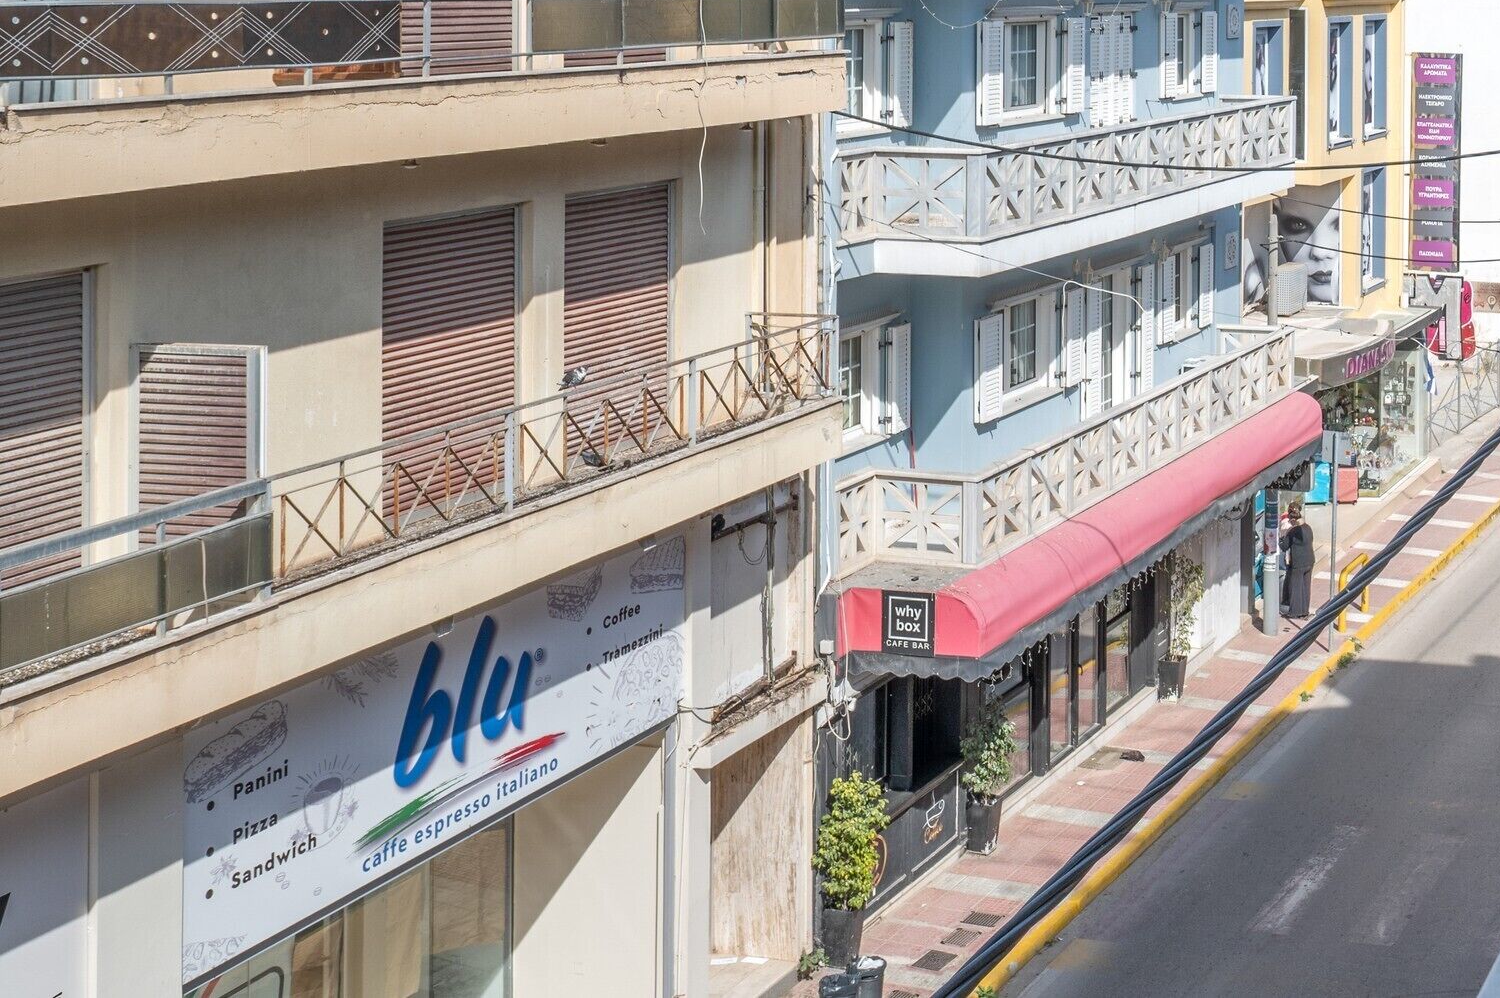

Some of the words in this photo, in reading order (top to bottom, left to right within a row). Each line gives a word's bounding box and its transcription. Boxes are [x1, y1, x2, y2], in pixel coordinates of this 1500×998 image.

[603, 604, 641, 629] Coffee
[895, 605, 922, 620] why
[896, 619, 921, 633] box
[602, 623, 663, 664] Tramezzini
[886, 639, 909, 649] CAFE
[912, 641, 930, 650] BAR
[393, 615, 533, 789] blu
[233, 759, 289, 800] Panini
[233, 813, 278, 844] Pizza
[362, 838, 407, 872] caffe
[414, 793, 491, 844] espresso
[496, 757, 558, 801] italiano
[231, 833, 317, 889] Sandwich
